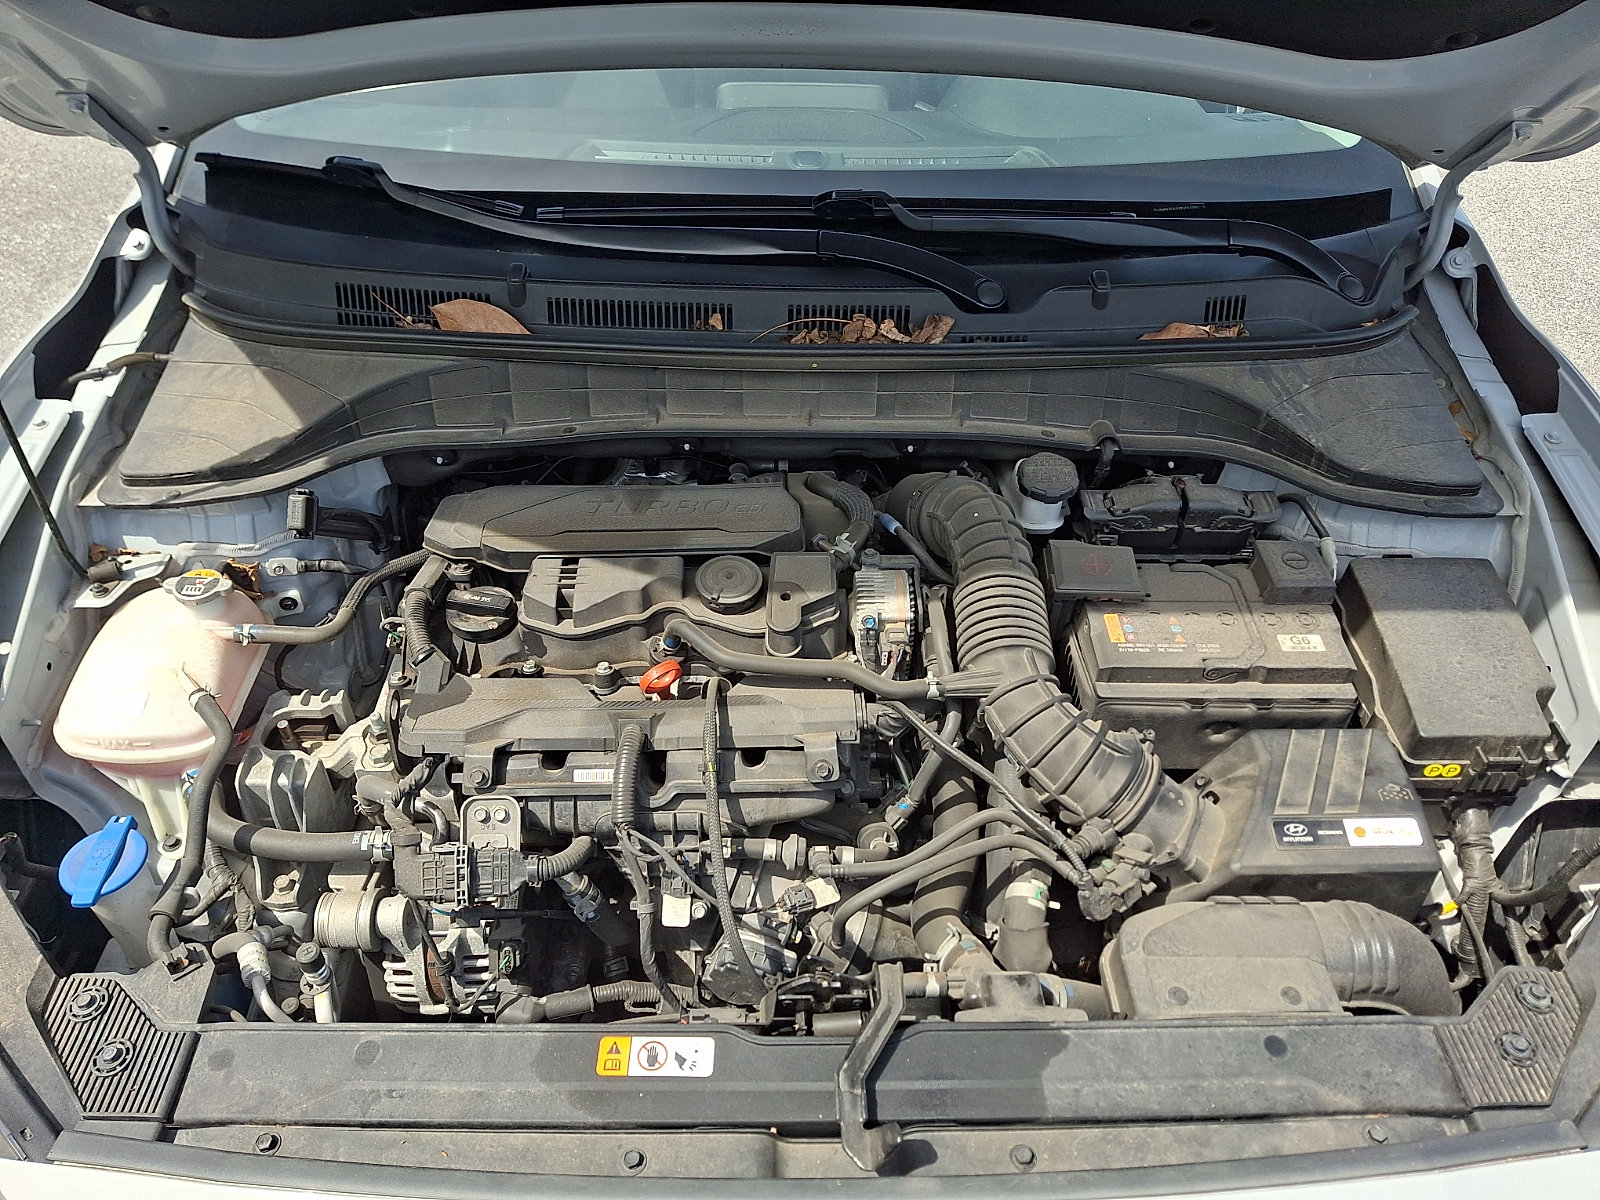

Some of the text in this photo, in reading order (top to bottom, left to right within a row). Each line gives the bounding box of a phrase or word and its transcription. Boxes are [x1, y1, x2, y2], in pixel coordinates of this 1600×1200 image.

[585, 499, 730, 517] TURBO
[1290, 635, 1311, 645] G6
[302, 946, 314, 957] H
